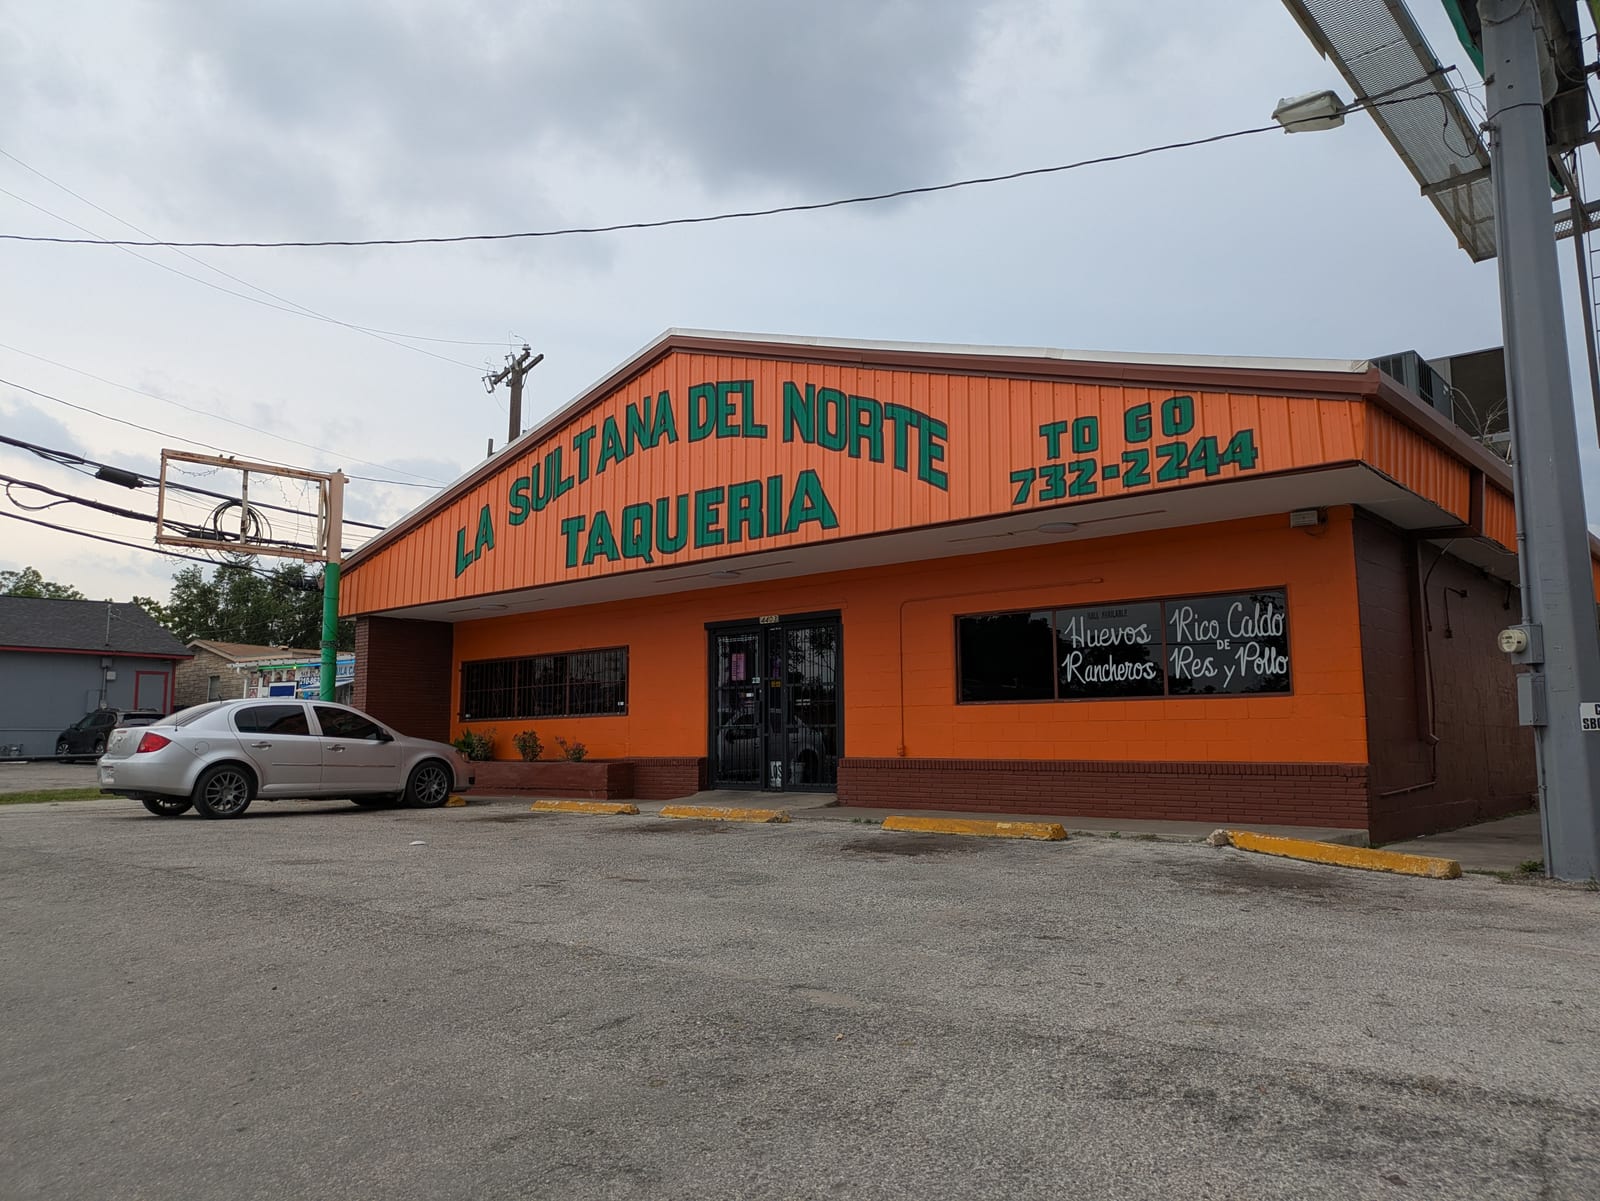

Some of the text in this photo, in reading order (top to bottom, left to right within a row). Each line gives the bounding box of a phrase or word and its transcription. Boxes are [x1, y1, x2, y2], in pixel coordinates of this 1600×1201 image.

[1039, 395, 1194, 460] TO GO
[455, 379, 949, 578] LA SULTANA DEL NORTE
[1010, 428, 1258, 505] 732-2244
[561, 468, 839, 568] TAQUERIA
[1064, 616, 1151, 649] Huevos
[1170, 601, 1285, 642] Rico Caldo
[1216, 639, 1231, 650] DE
[1061, 651, 1156, 684] Rancheros
[1170, 642, 1288, 688] Res y Pollo
